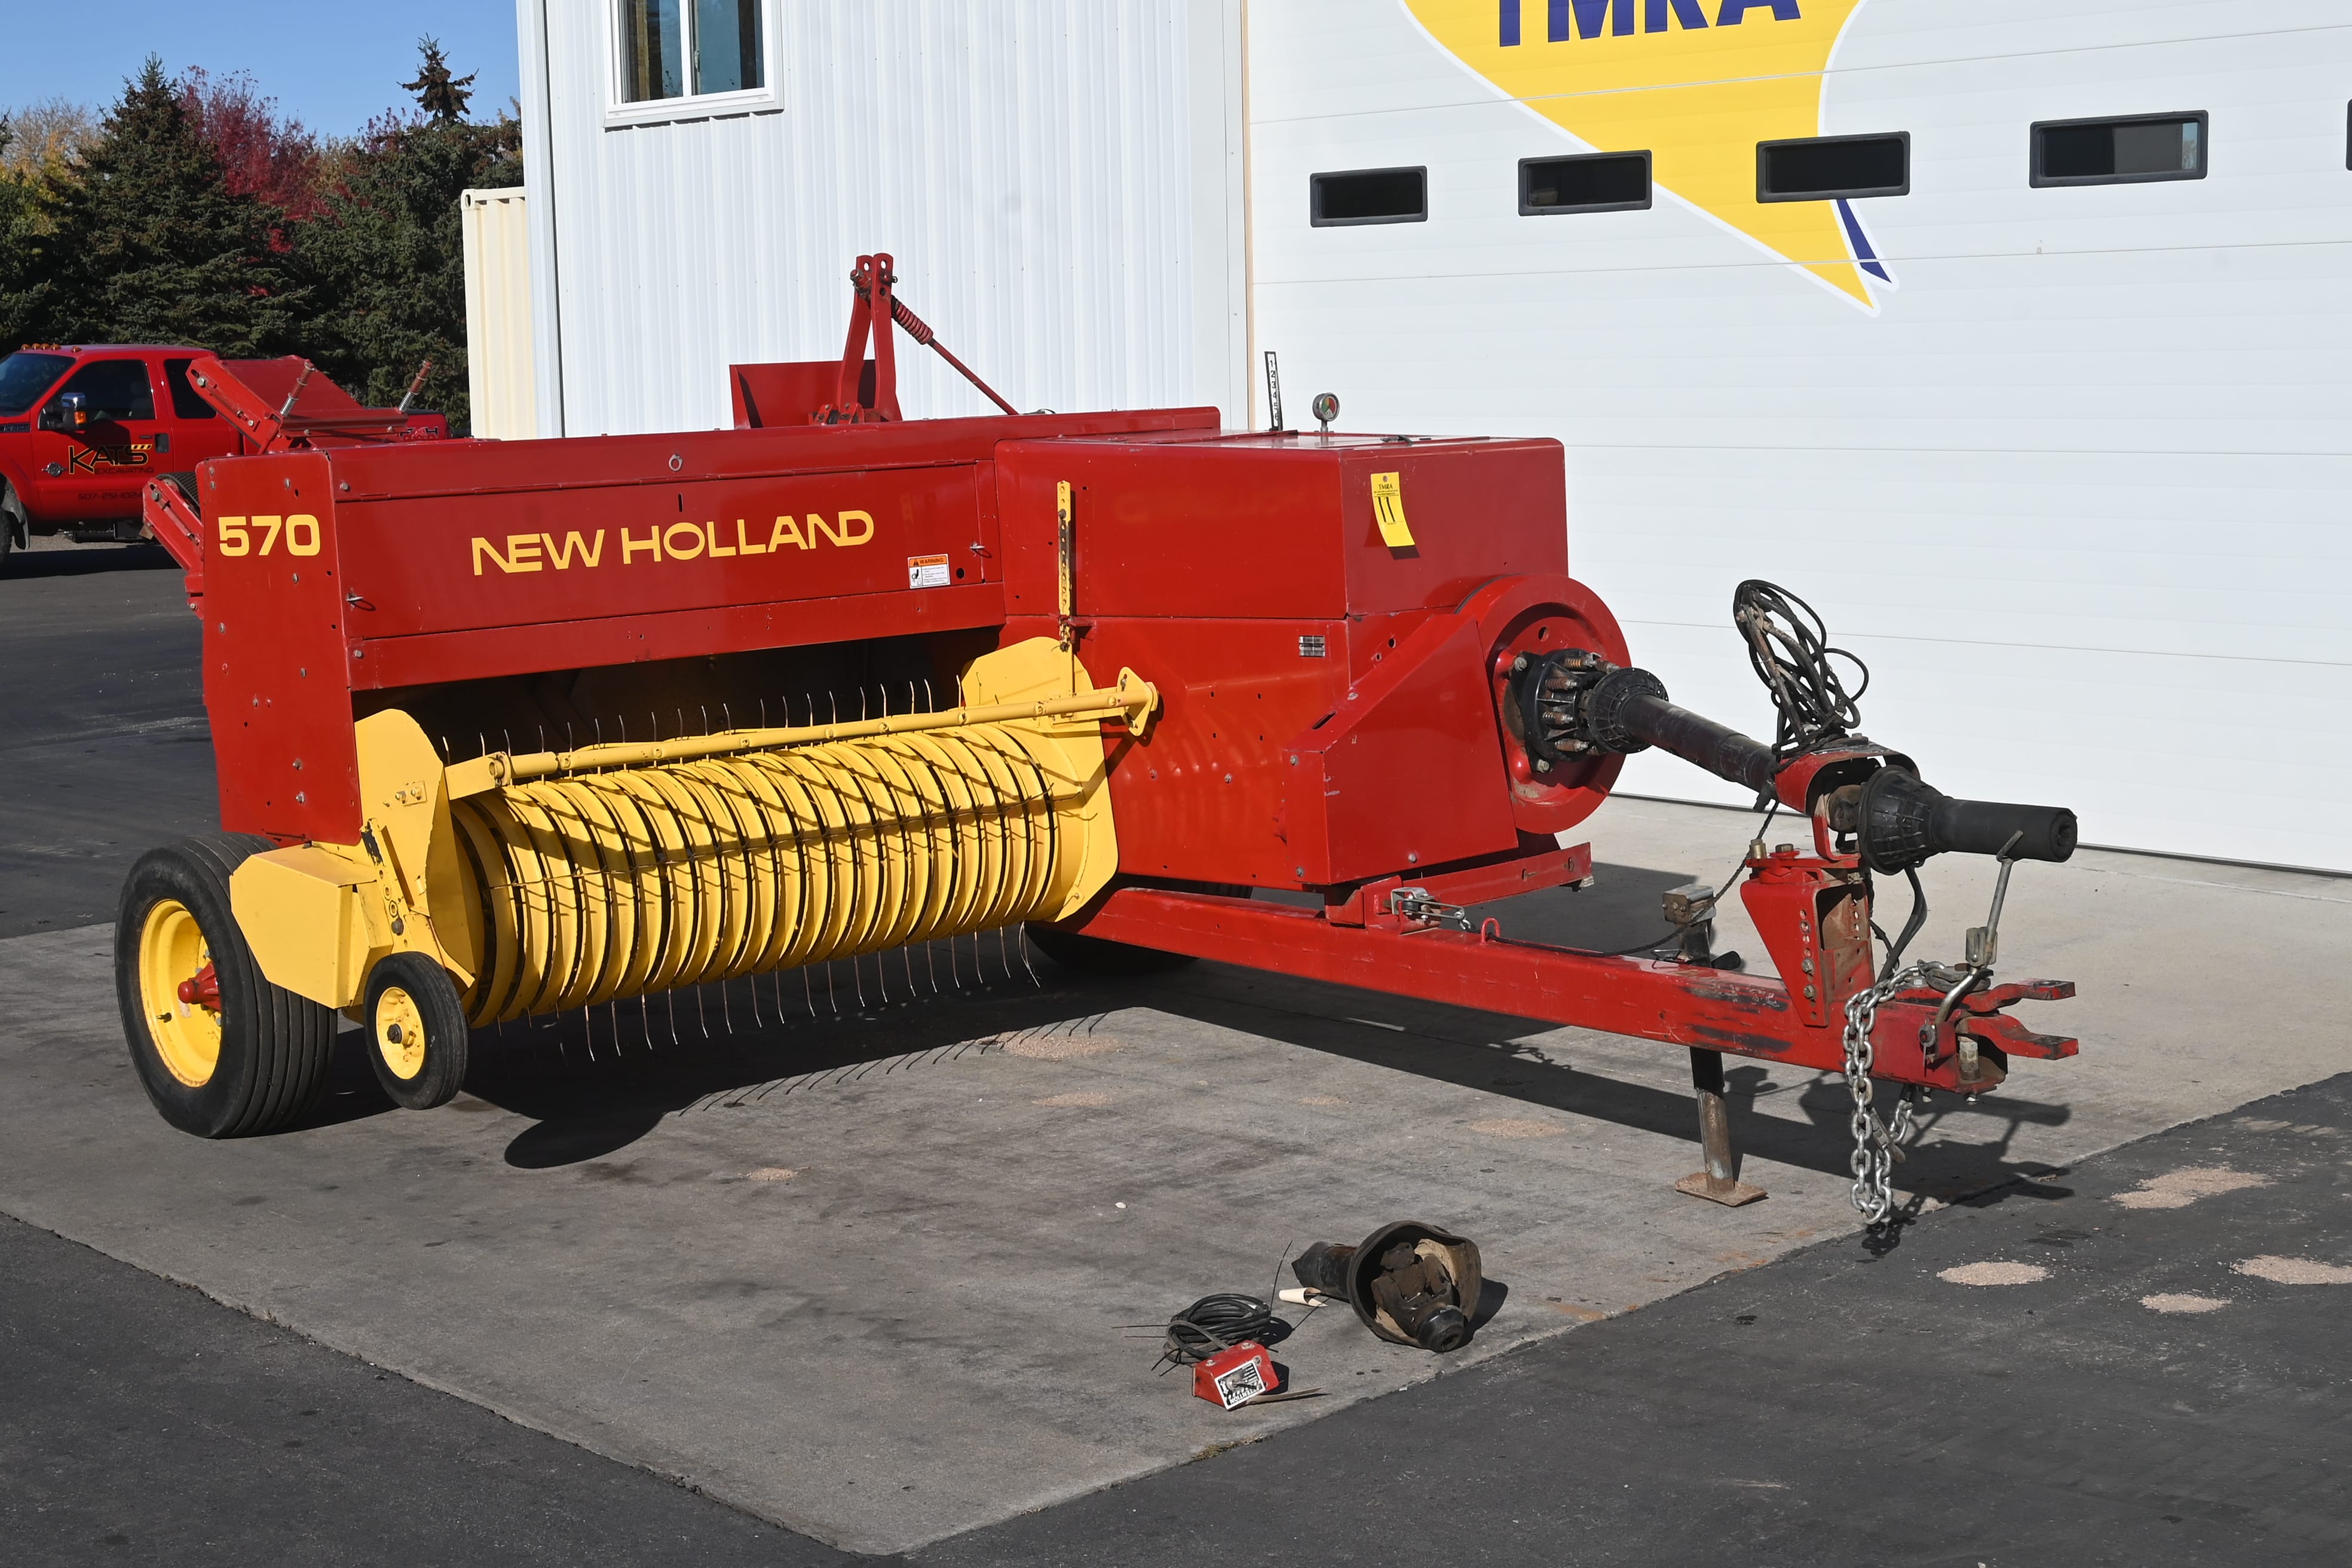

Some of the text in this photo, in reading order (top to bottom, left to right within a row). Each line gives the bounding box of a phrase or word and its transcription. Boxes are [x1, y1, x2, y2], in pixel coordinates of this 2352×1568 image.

[68, 444, 153, 474] KATS
[218, 514, 321, 556] 570
[471, 510, 875, 576] NEW HOLLAND
